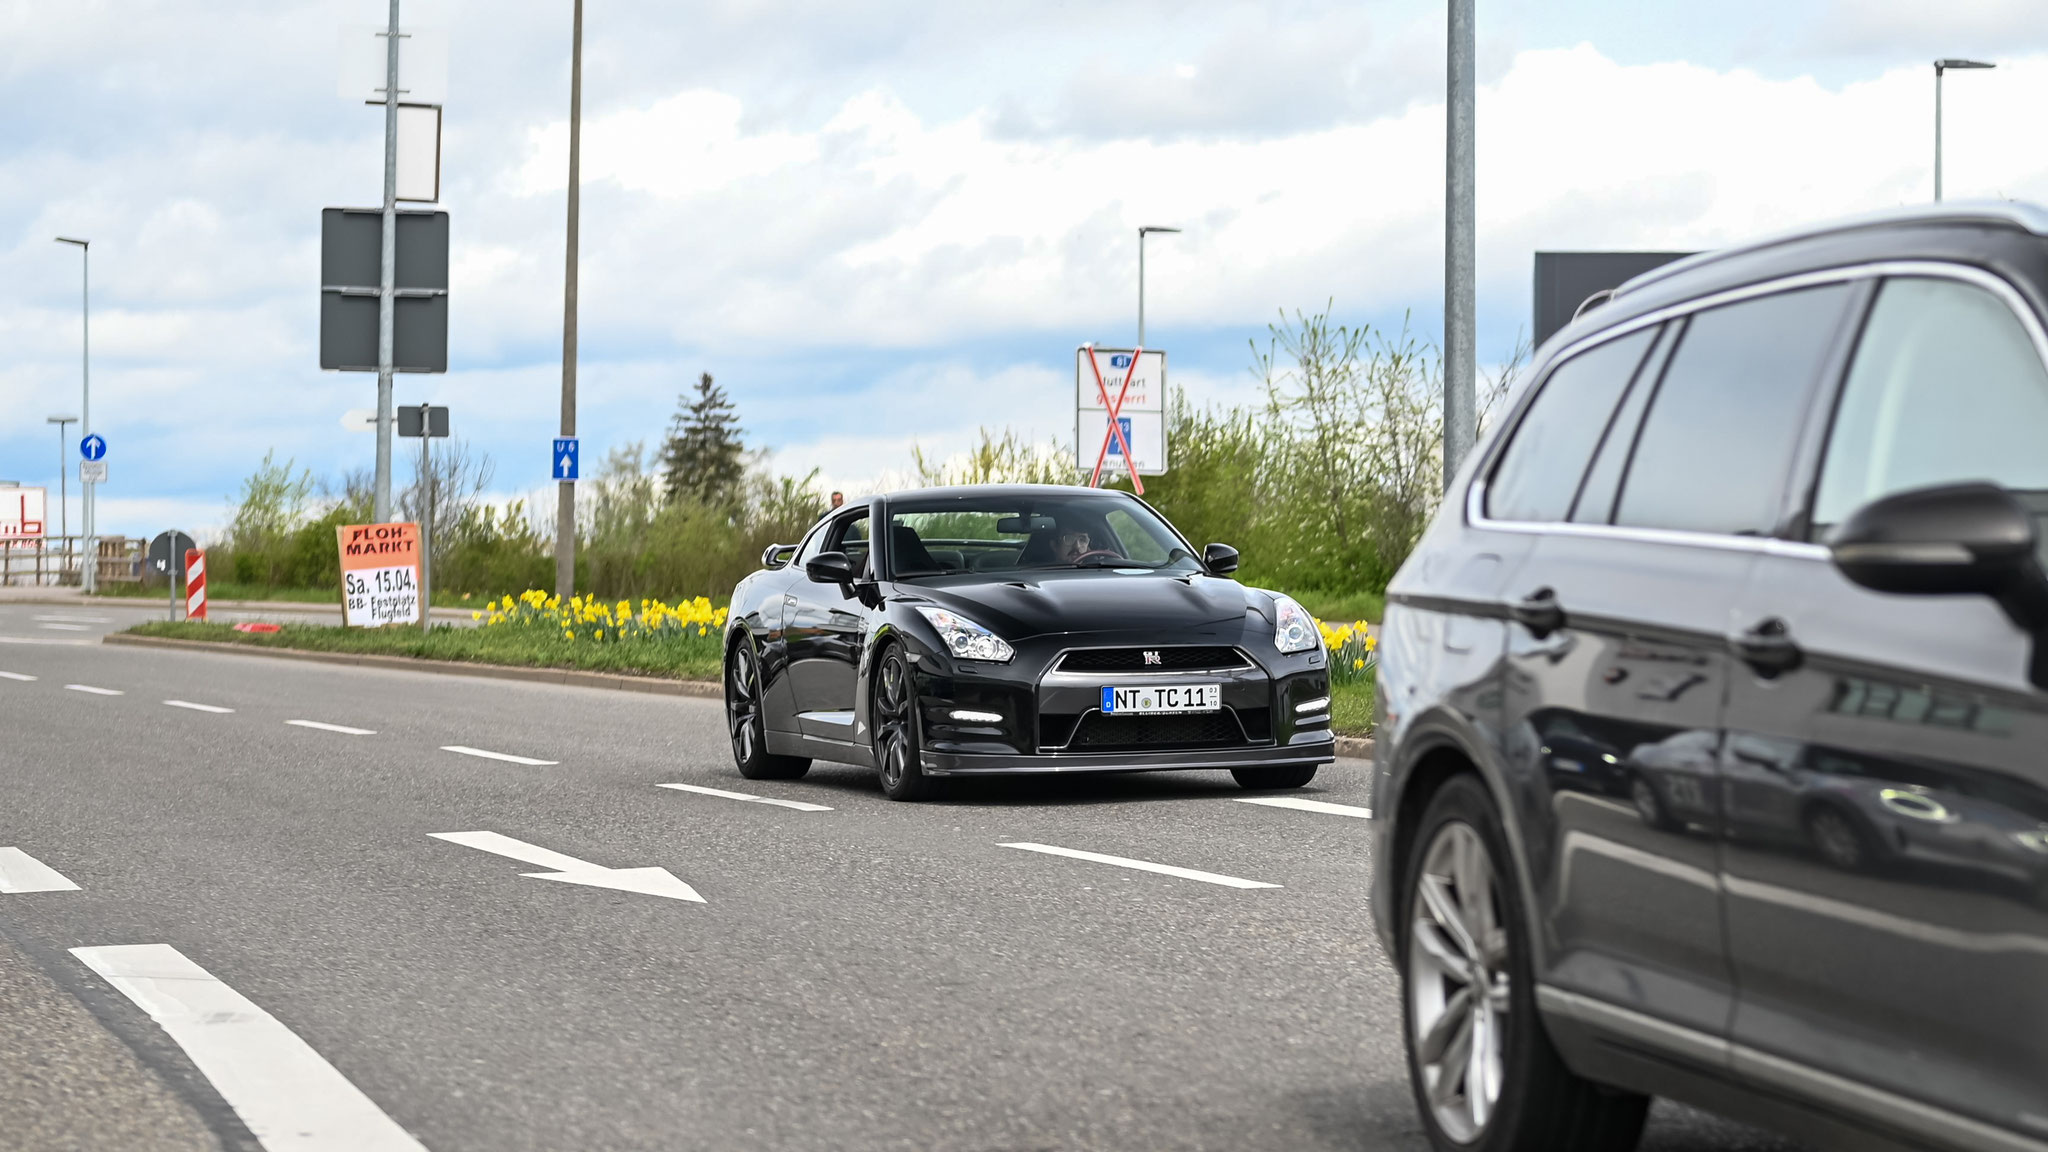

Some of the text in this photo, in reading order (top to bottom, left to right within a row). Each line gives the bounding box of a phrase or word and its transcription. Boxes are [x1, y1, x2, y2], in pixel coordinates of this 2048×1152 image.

[556, 441, 565, 453] U
[346, 541, 414, 556] MARKT
[346, 568, 416, 595] Sa. 15.04.
[371, 606, 411, 623] Flugfeld
[1115, 687, 1207, 709] NT TC 11
